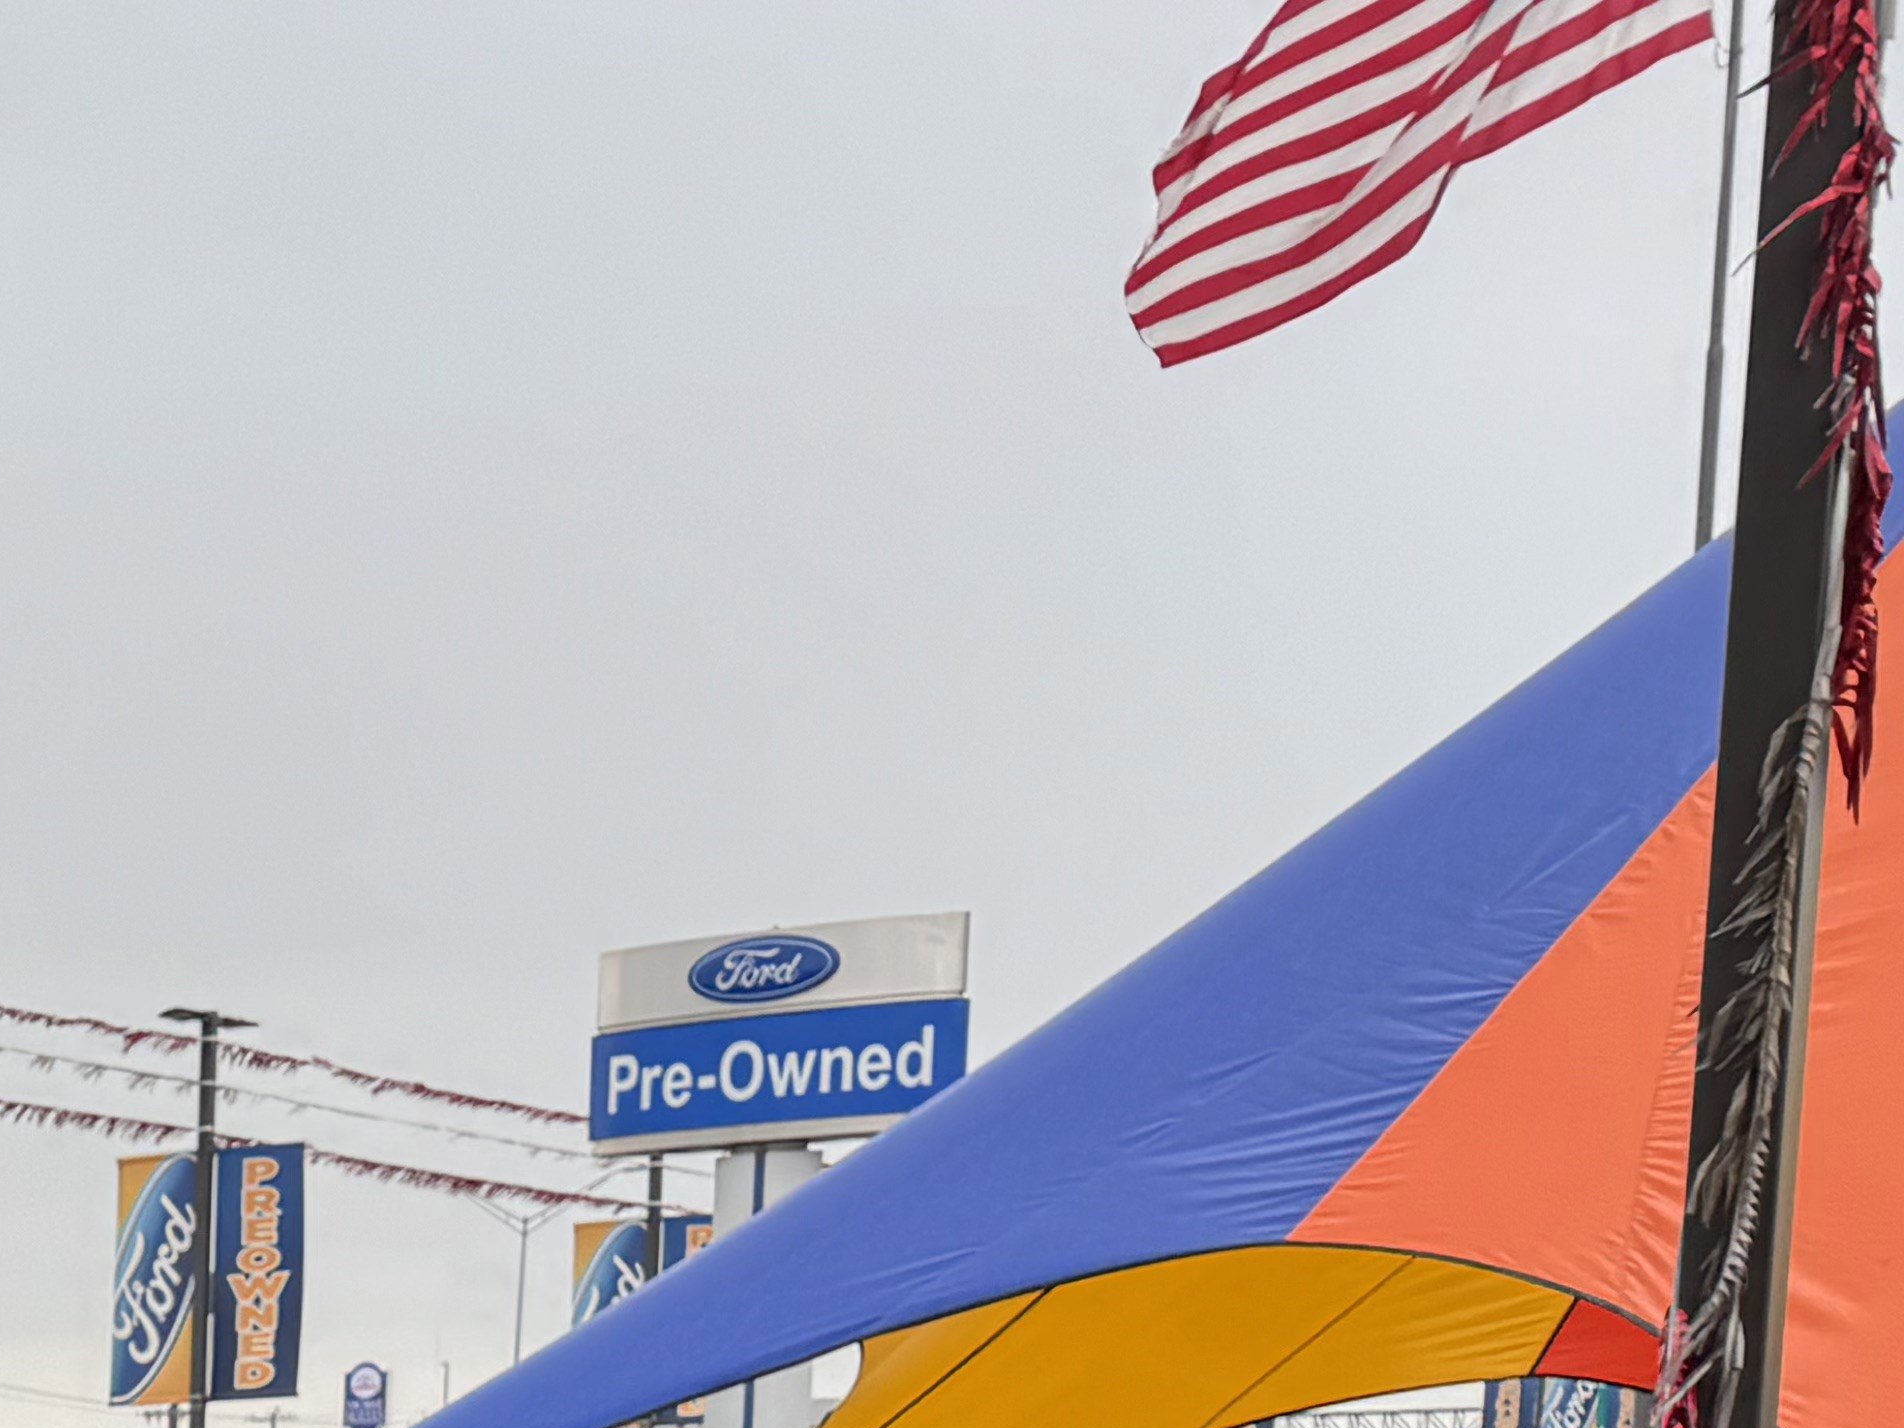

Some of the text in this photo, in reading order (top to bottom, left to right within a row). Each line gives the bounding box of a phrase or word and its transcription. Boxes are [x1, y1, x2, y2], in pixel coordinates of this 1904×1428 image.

[715, 947, 803, 992] Ford
[607, 1024, 936, 1115] Pre-Owned
[112, 1194, 197, 1365] Ford
[226, 1156, 292, 1391] PREOWNED
